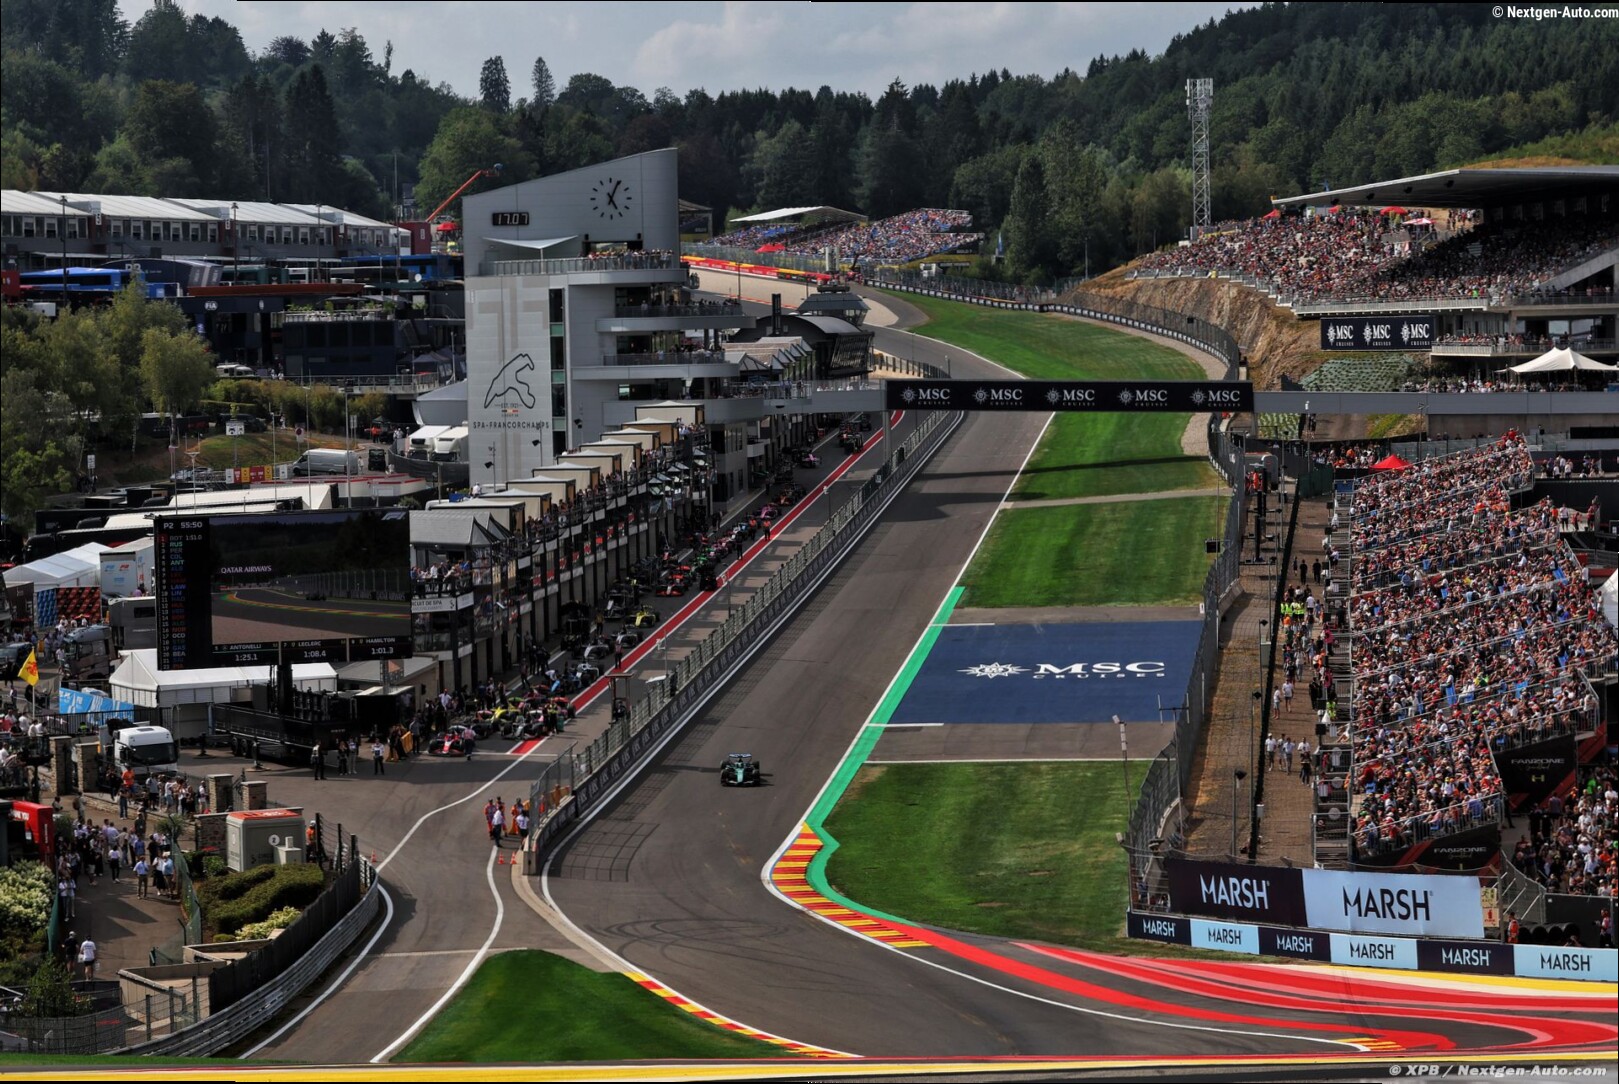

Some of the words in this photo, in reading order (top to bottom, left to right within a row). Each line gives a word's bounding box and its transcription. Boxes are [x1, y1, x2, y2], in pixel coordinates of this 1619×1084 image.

[1336, 325, 1353, 339] MSC
[1373, 325, 1391, 338] MSC
[1411, 324, 1430, 338] MSC
[918, 389, 950, 400] MSC
[990, 389, 1022, 400] MSC
[1063, 390, 1095, 400] MSC
[1135, 390, 1168, 401] MSC
[1208, 390, 1240, 401] MSC
[220, 566, 243, 574] QATAR
[244, 565, 272, 573] AIRWAYS
[235, 653, 258, 661] 1:25.1
[1034, 662, 1165, 674] MSC
[1200, 874, 1269, 910] MARSH
[1343, 886, 1430, 921] MARSH
[1143, 918, 1175, 937] MARSH
[1208, 928, 1241, 945] MARSH
[1276, 934, 1312, 953] MARSH
[1350, 942, 1394, 960] MARSH
[1442, 947, 1490, 966] MARSH
[1540, 953, 1590, 971] MARSH
